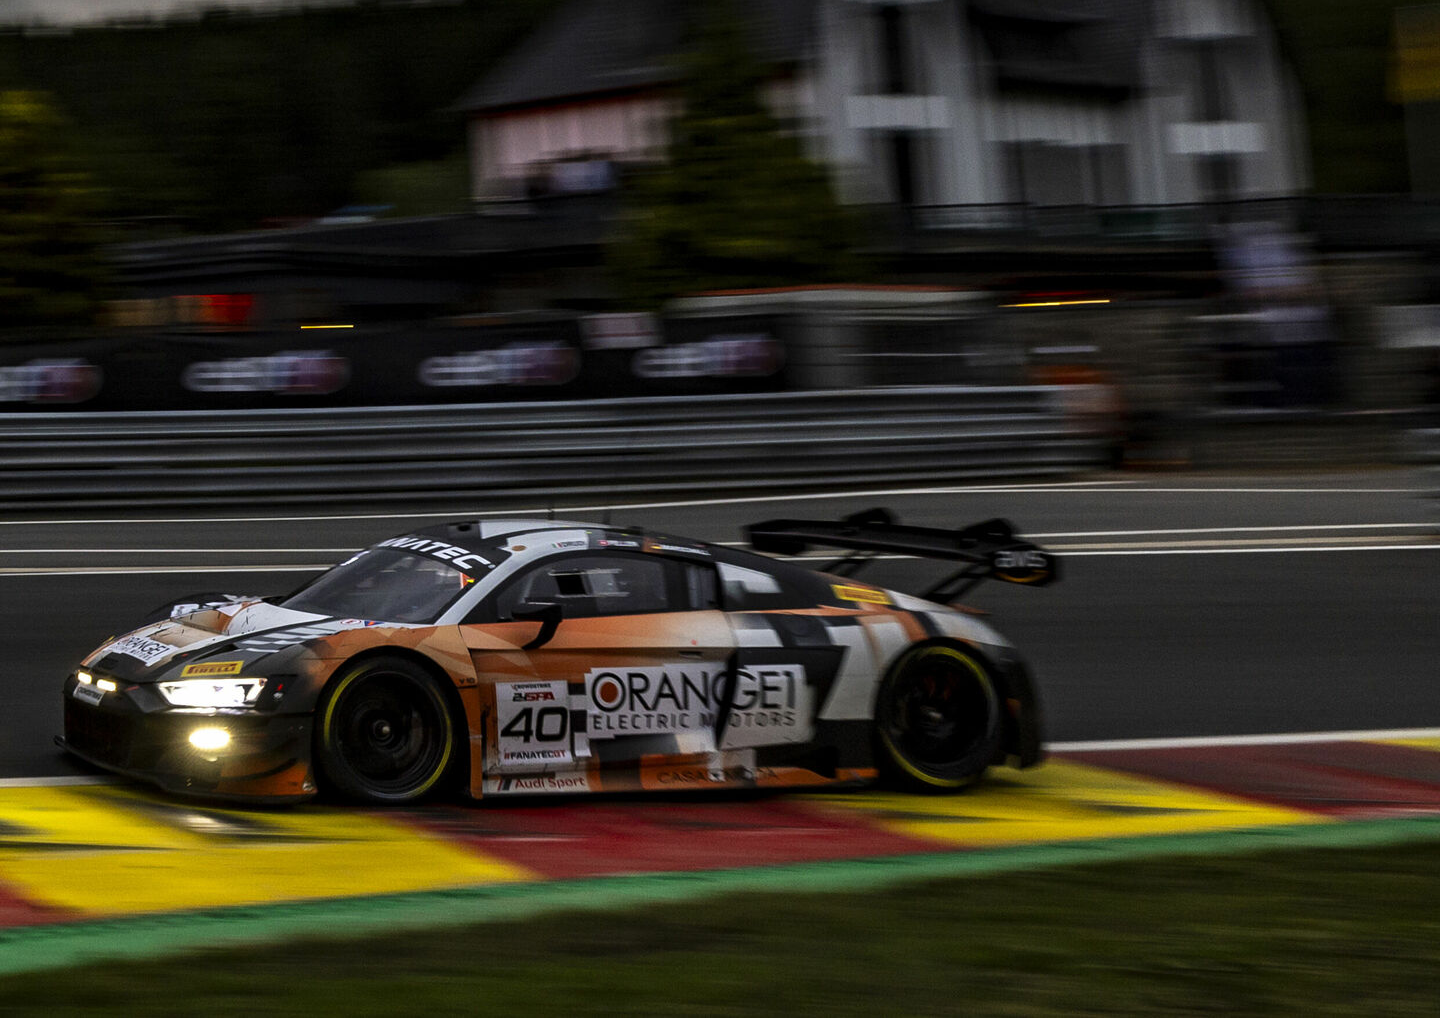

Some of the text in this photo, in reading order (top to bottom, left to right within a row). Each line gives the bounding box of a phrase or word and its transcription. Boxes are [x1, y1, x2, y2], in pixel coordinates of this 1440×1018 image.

[187, 663, 237, 674] PIRELLI
[591, 669, 796, 712] ORANGE1
[501, 706, 568, 744] 40
[592, 711, 796, 730] ELECTRIC MOTORS
[515, 776, 586, 789] Audi Sport
